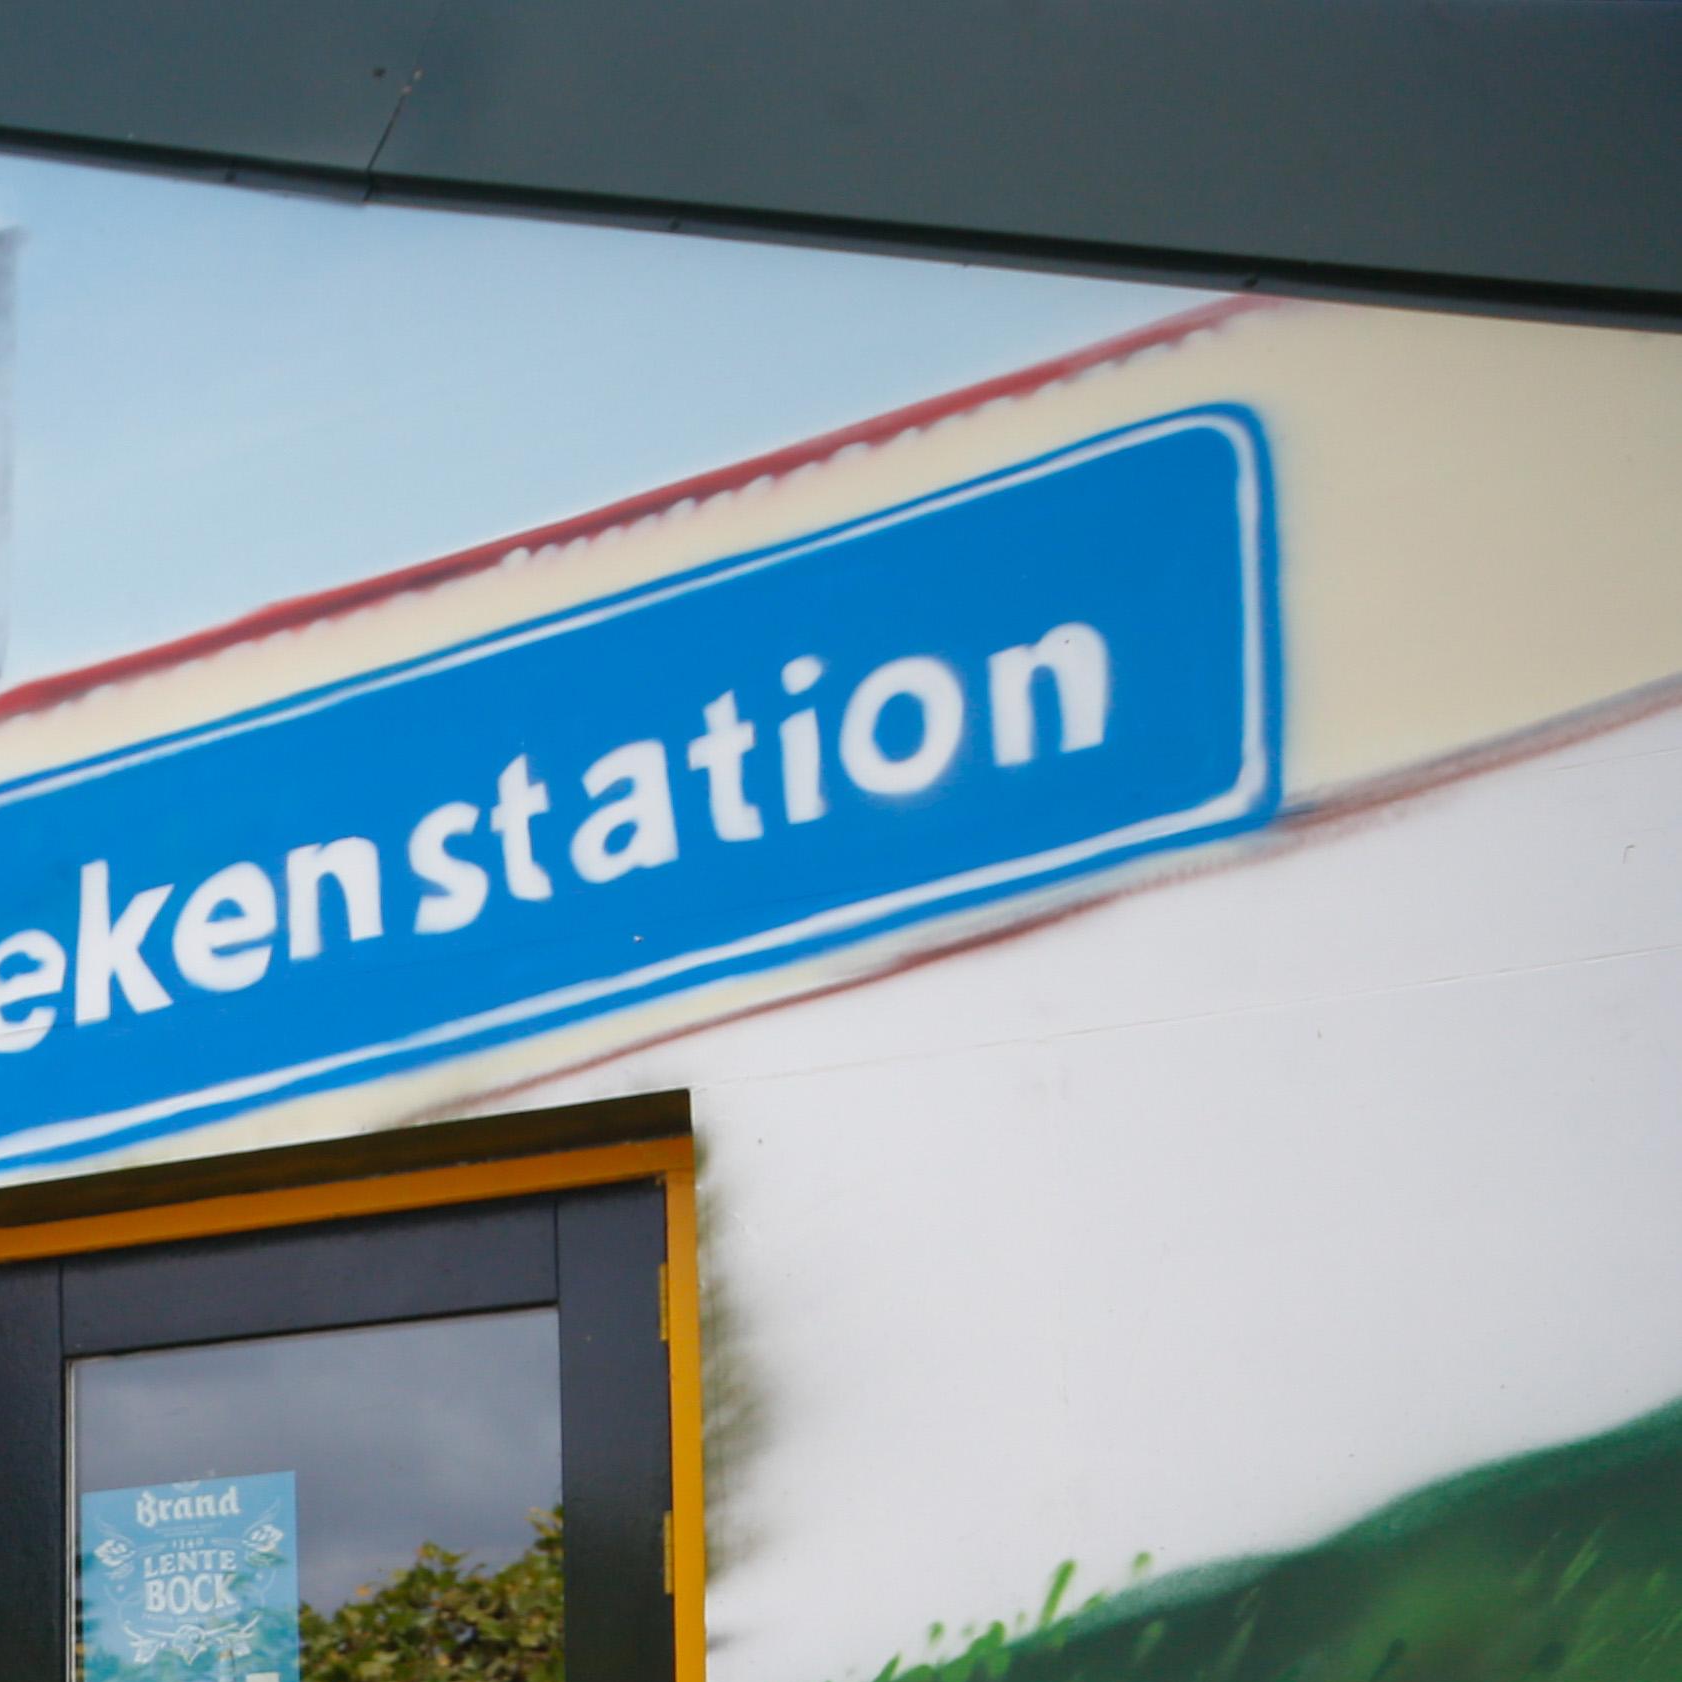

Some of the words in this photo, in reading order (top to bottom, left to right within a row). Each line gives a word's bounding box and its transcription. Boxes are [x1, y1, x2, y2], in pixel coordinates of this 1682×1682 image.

[137, 1485, 240, 1527] Brand
[143, 1549, 237, 1578] LENTE
[145, 1573, 238, 1614] BOCK
